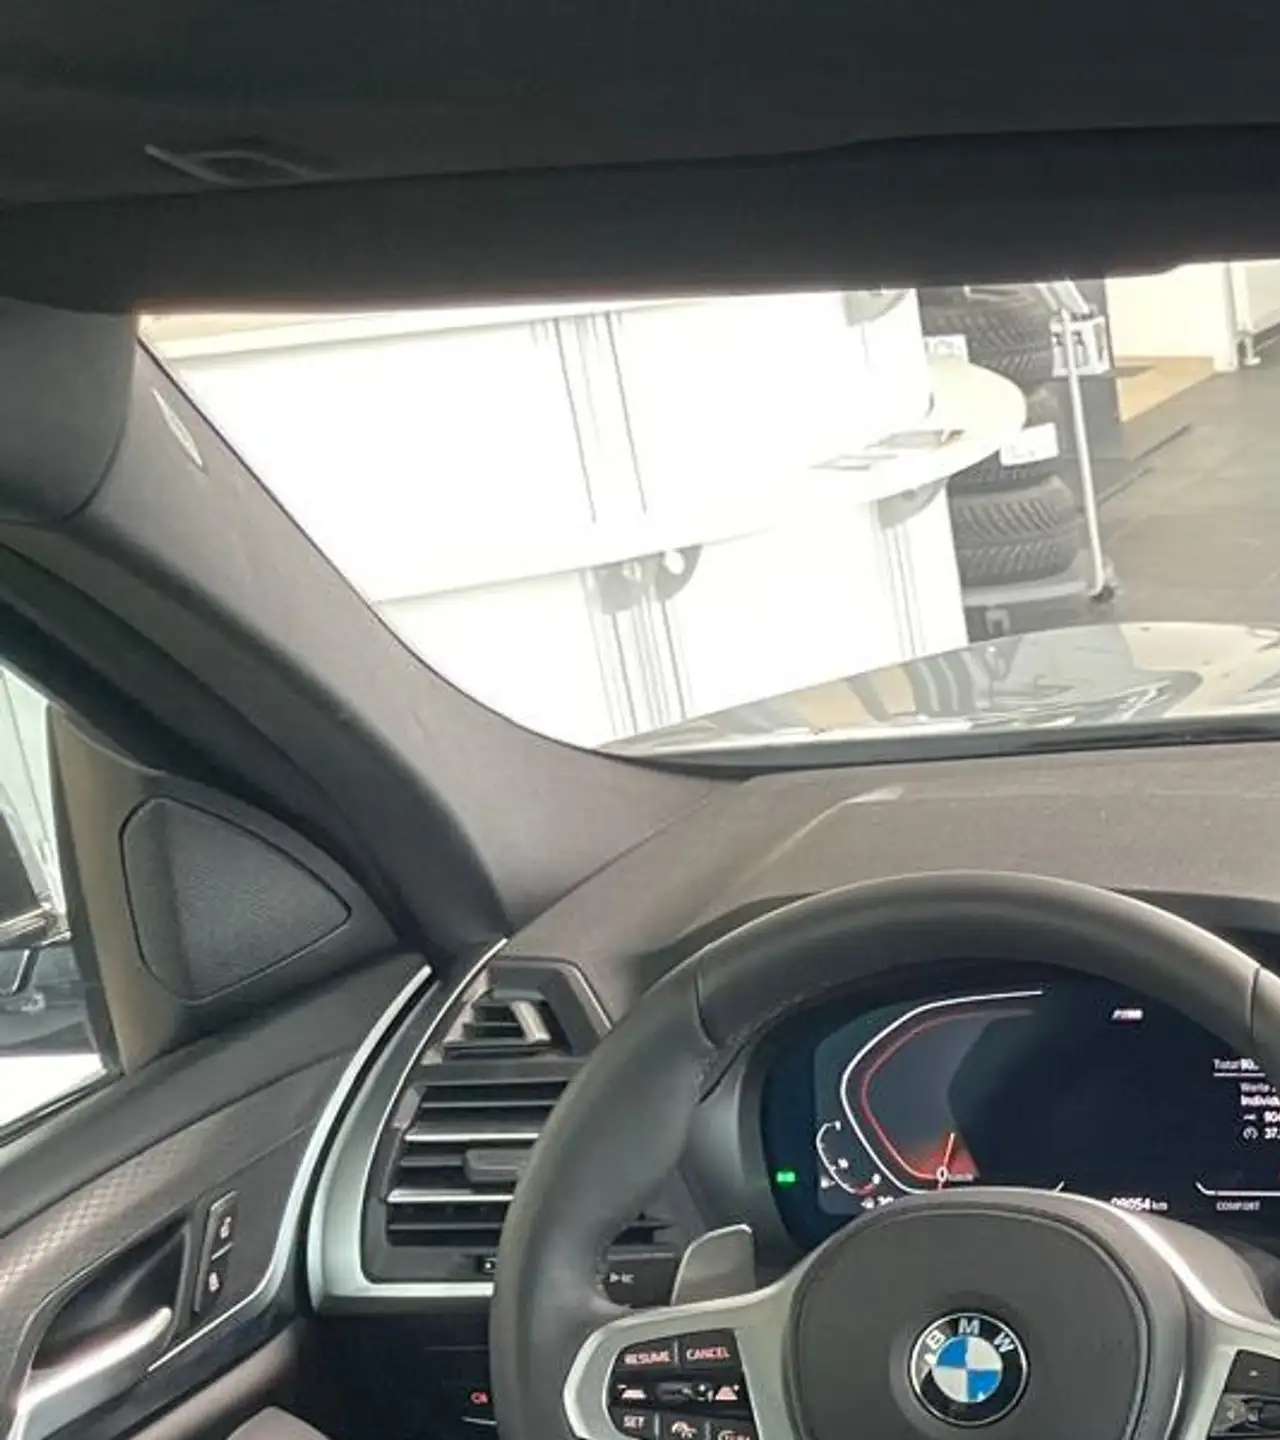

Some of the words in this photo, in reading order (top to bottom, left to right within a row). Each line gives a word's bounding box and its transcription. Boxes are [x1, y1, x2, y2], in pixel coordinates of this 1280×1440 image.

[926, 1318, 1016, 1353] BMW
[624, 1350, 671, 1365] RESUME
[686, 1346, 730, 1361] CANCEL
[623, 1415, 645, 1429] SET
